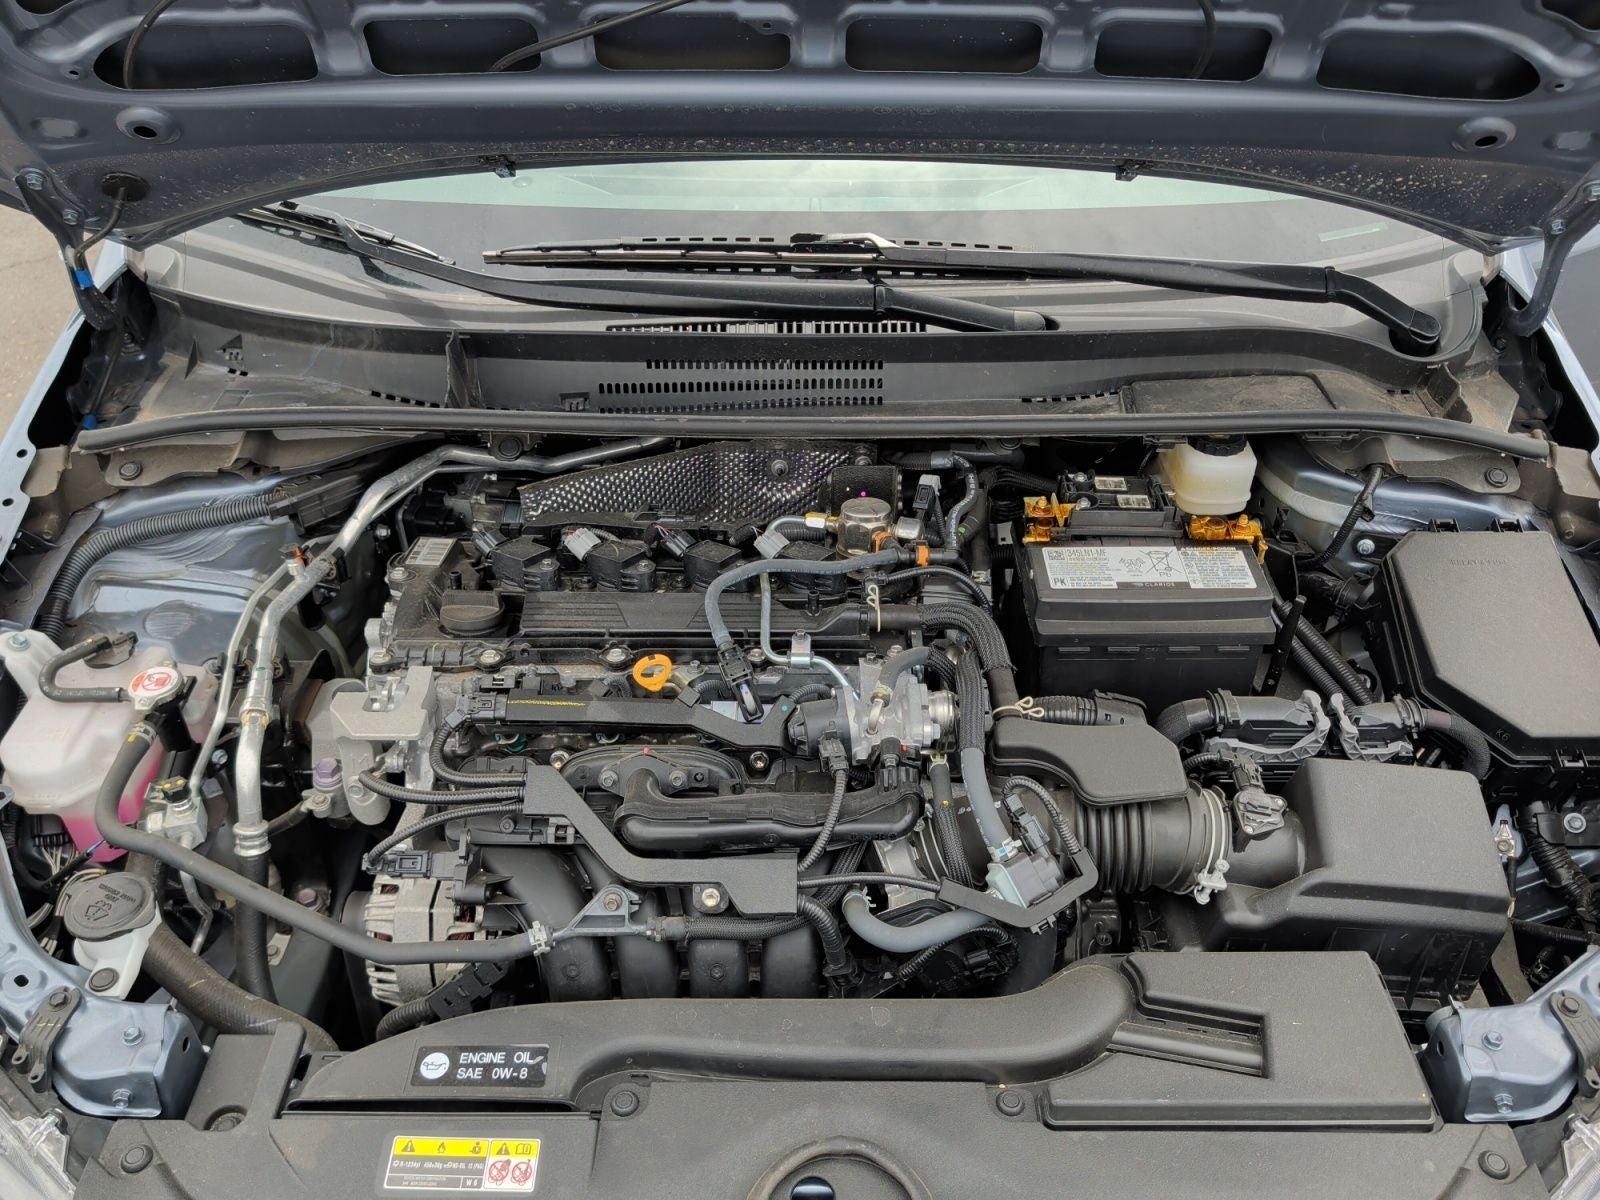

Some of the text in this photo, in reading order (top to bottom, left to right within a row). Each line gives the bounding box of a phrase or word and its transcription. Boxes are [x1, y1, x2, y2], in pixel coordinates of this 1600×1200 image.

[1053, 577, 1066, 586] PK
[459, 1052, 533, 1064] ENGINE OIL
[456, 1067, 528, 1079] SAE 0W-8
